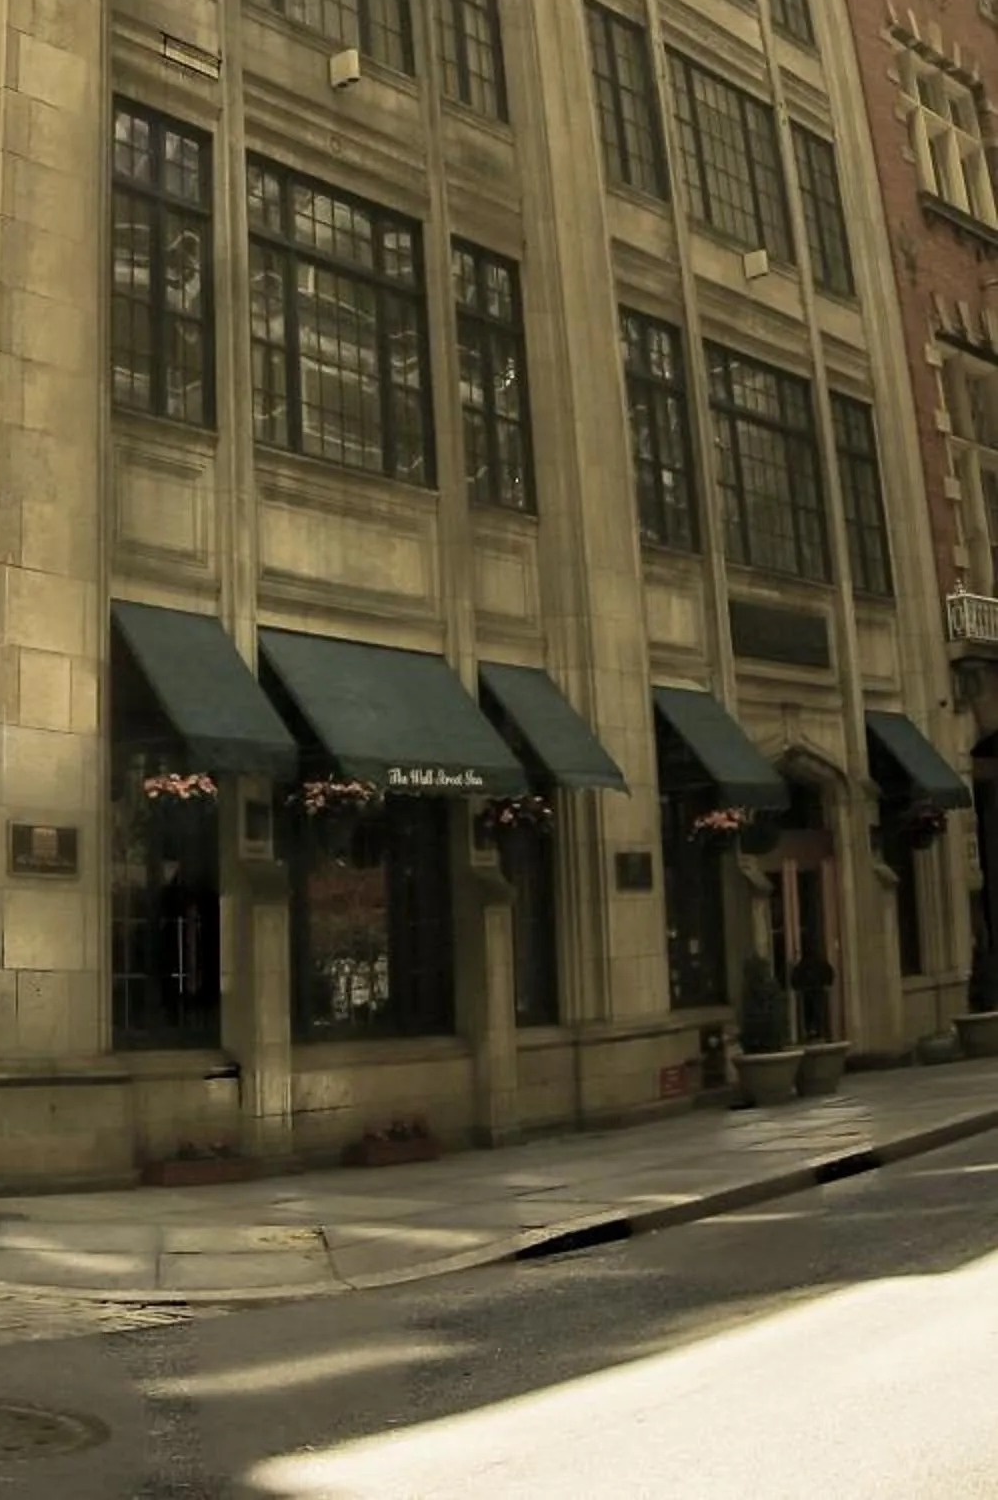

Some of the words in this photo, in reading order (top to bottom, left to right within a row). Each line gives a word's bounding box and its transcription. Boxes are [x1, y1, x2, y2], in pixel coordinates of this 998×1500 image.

[388, 768, 408, 785] The
[409, 768, 433, 786] Wall
[435, 768, 463, 786] Street
